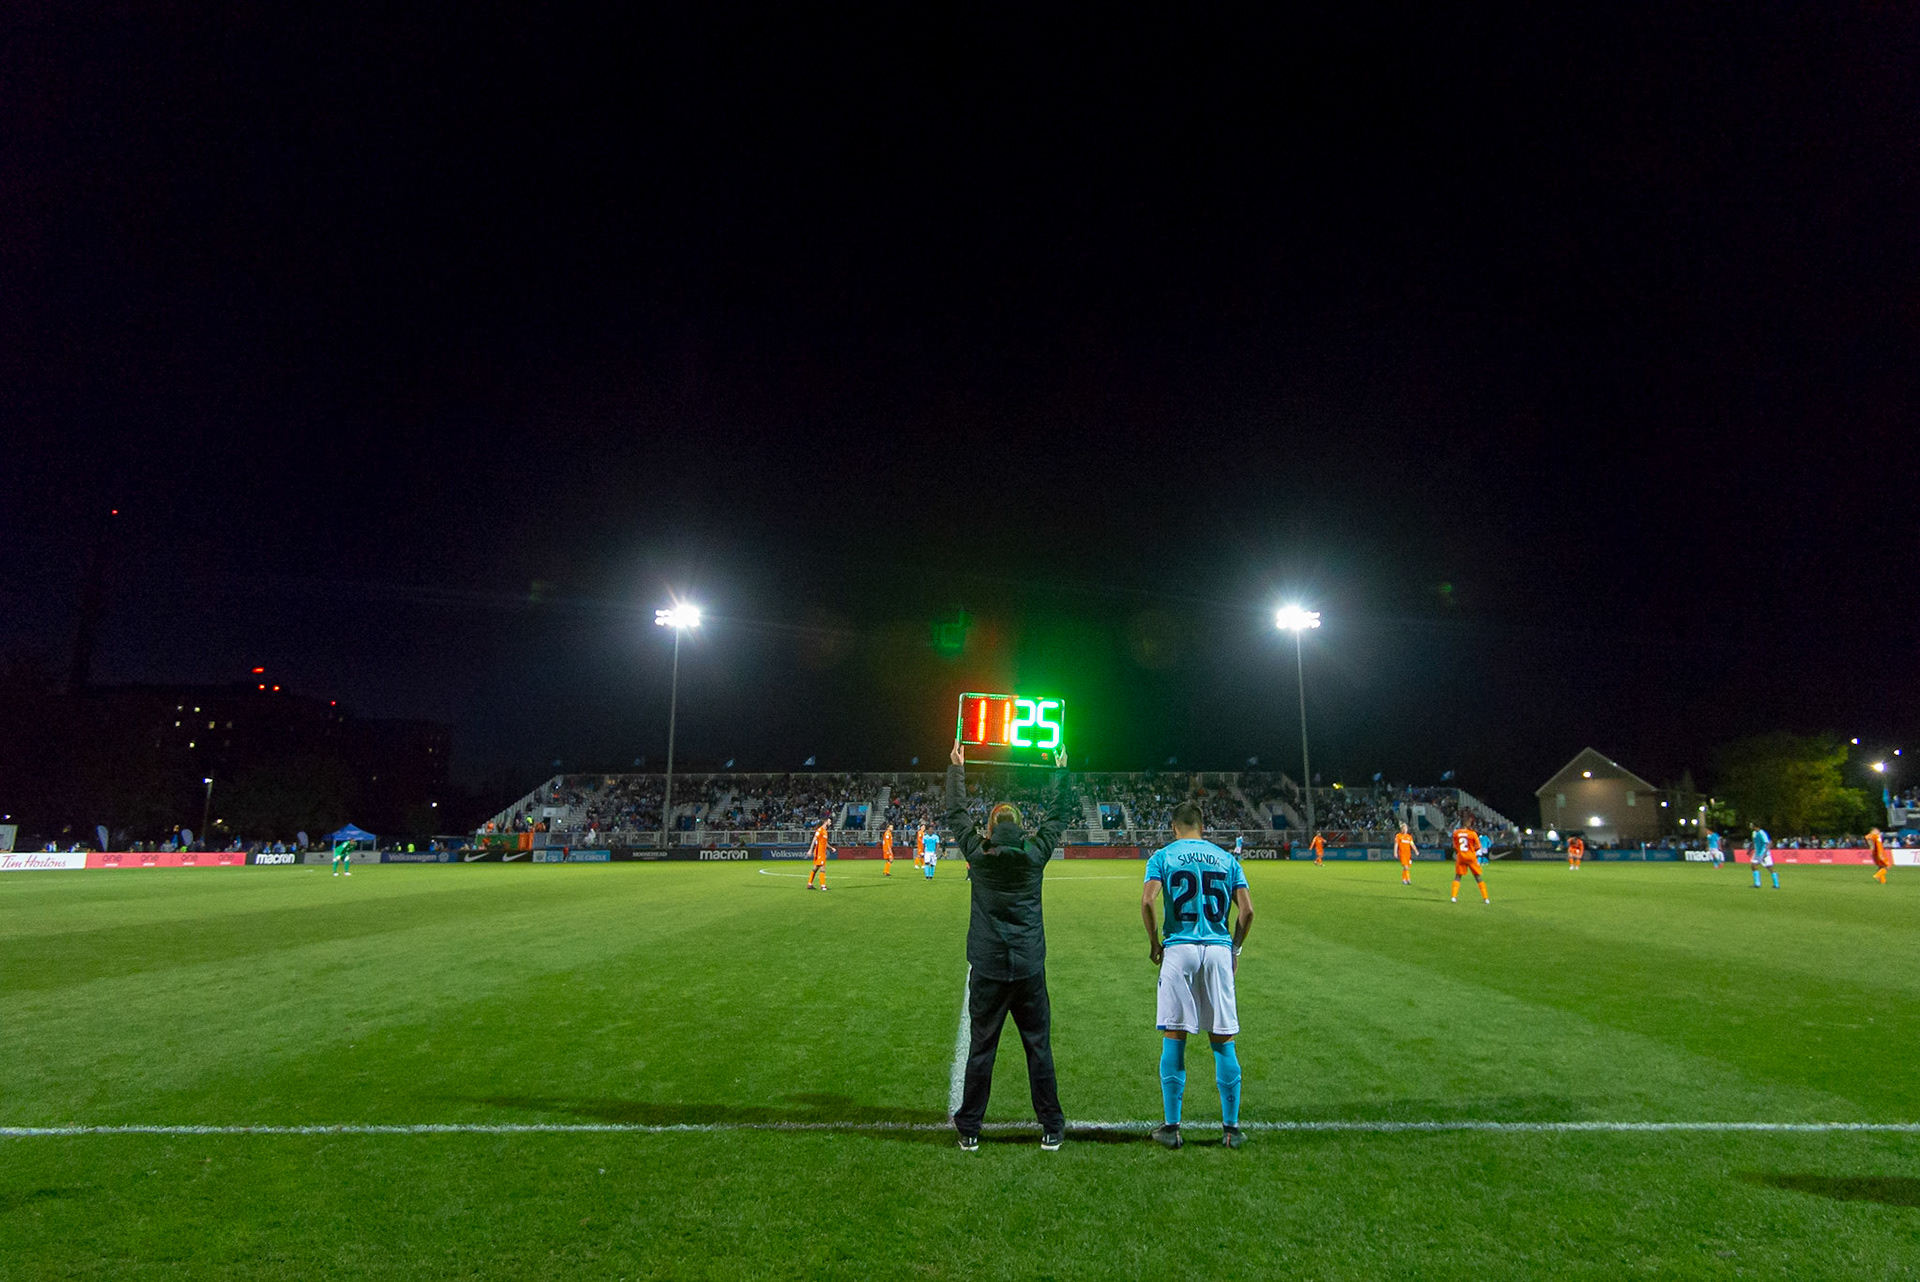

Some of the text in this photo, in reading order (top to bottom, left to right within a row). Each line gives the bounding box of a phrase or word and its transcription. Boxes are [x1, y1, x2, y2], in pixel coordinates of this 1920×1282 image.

[1010, 699, 1060, 749] 25
[1458, 837, 1469, 852] 2
[102, 854, 122, 862] one
[140, 854, 159, 862] one
[255, 853, 295, 864] macron
[388, 853, 437, 862] Volkswagen
[699, 850, 749, 860] macron
[770, 850, 809, 859] Volkswag
[1240, 849, 1278, 859] acron
[1, 854, 66, 868] Tim Hortons
[1170, 870, 1228, 923] 25
